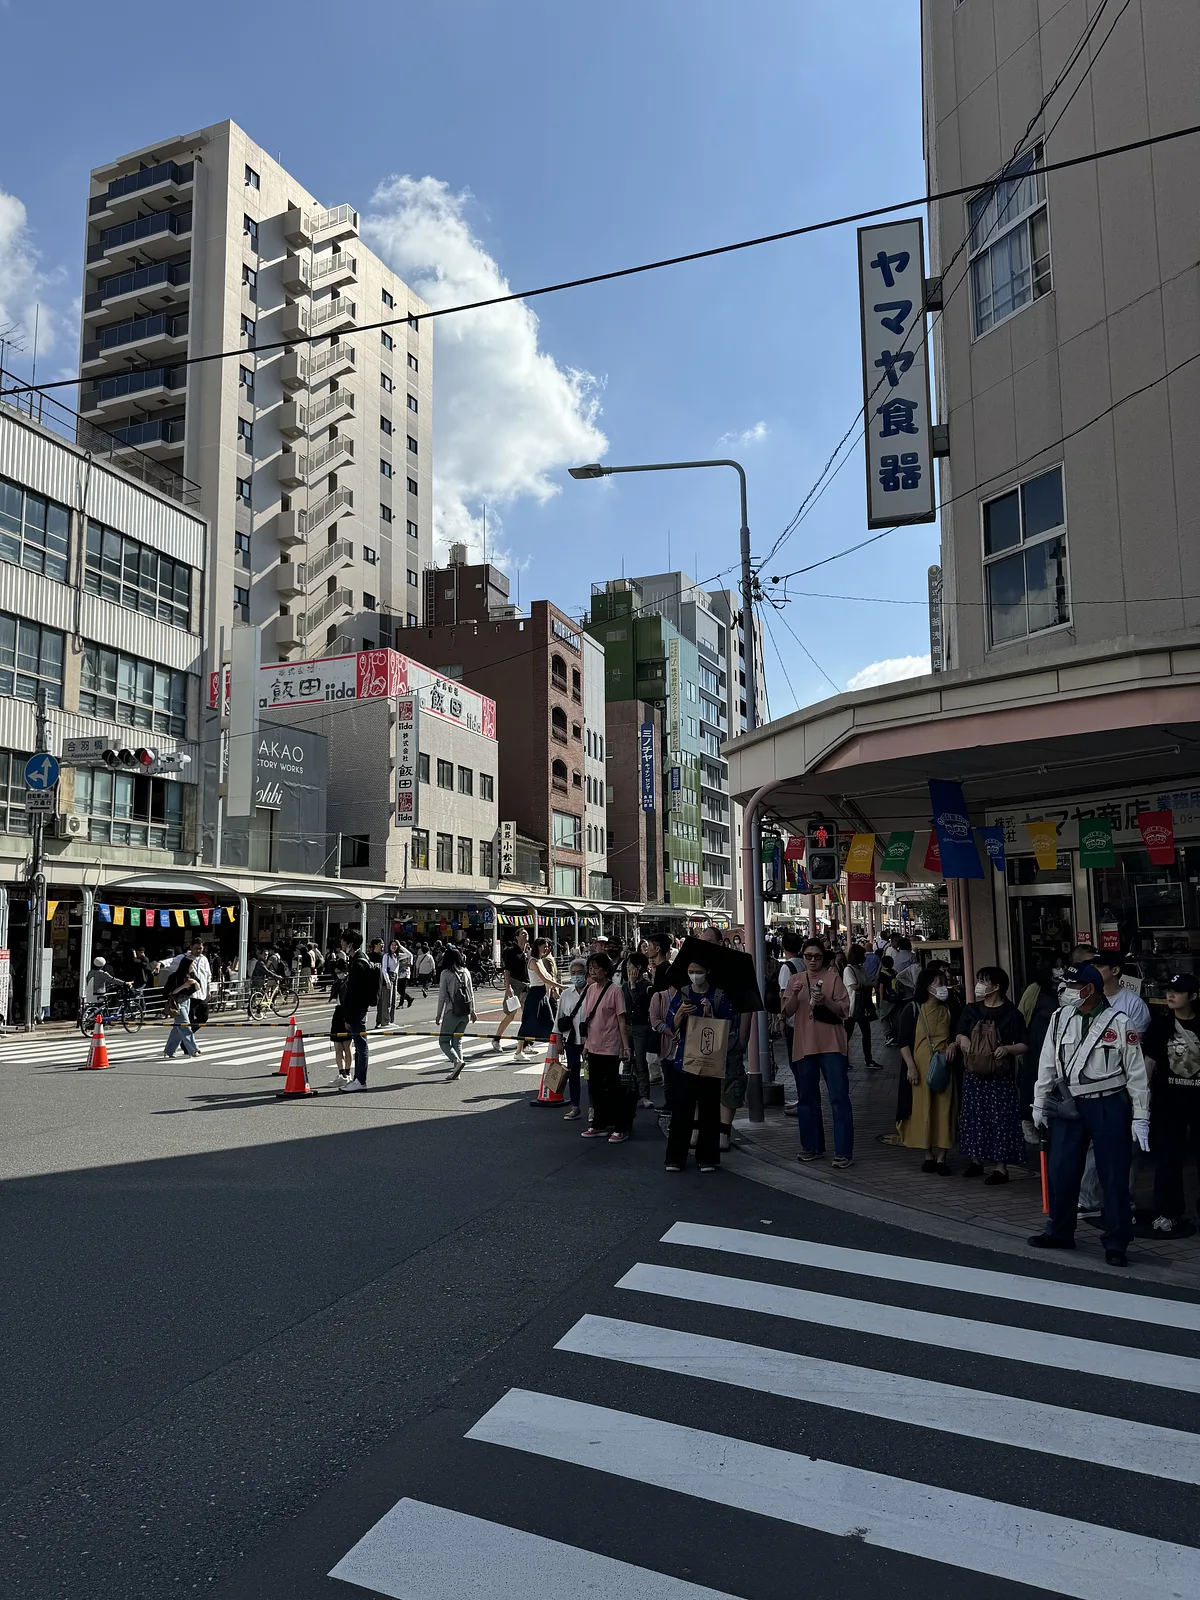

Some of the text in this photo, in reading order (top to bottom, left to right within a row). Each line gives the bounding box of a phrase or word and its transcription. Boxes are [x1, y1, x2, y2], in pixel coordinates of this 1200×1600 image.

[870, 250, 922, 493] ヤマヤ食器
[271, 678, 322, 703] 飯田
[325, 681, 357, 700] iida
[430, 684, 462, 718] 飯田
[398, 723, 413, 731] iida
[466, 712, 481, 733] iida
[68, 740, 103, 752] 合羽橋
[257, 739, 304, 763] AKAO
[280, 762, 304, 775] WORKS
[398, 764, 413, 789] 飯田
[398, 813, 413, 822] iida
[503, 841, 512, 873] 小松屋
[1126, 981, 1139, 992] Pay
